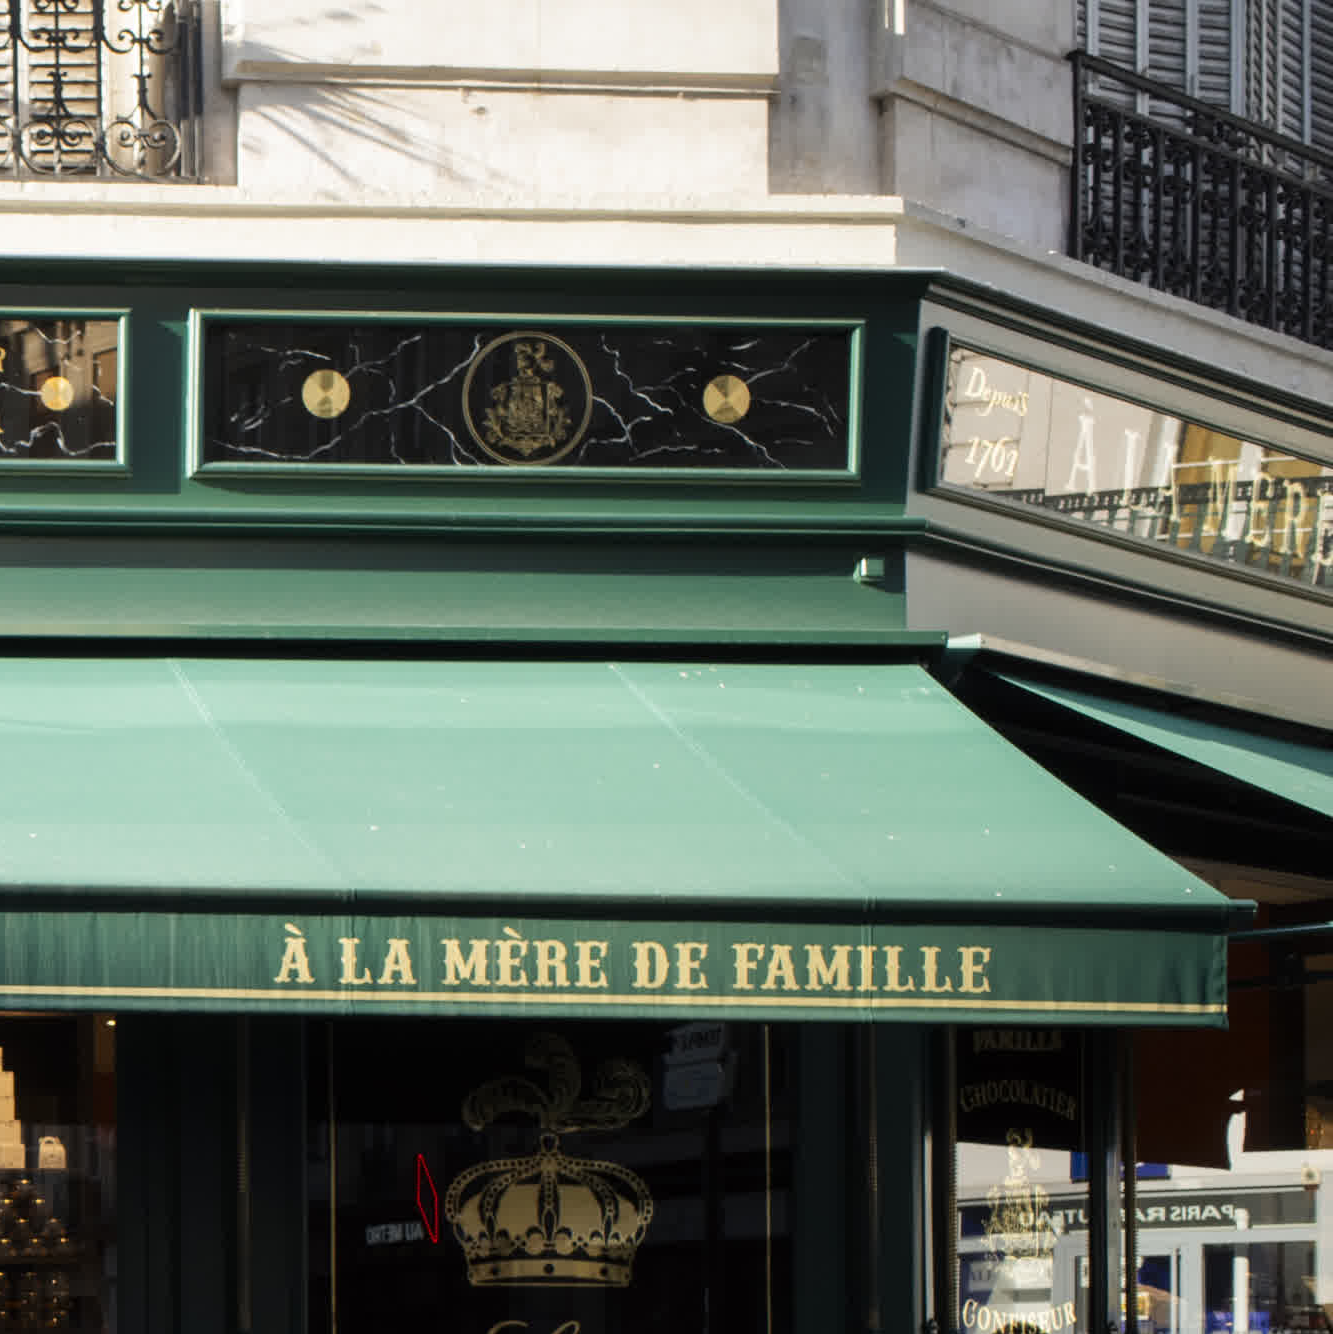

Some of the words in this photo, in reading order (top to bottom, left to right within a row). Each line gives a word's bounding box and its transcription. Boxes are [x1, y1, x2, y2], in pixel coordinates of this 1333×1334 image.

[964, 436, 1020, 477] 1761
[273, 923, 316, 985] À
[338, 937, 416, 986] LA
[441, 925, 609, 989] MÈRE
[632, 940, 711, 990] DE
[732, 942, 993, 994] FAMILLE
